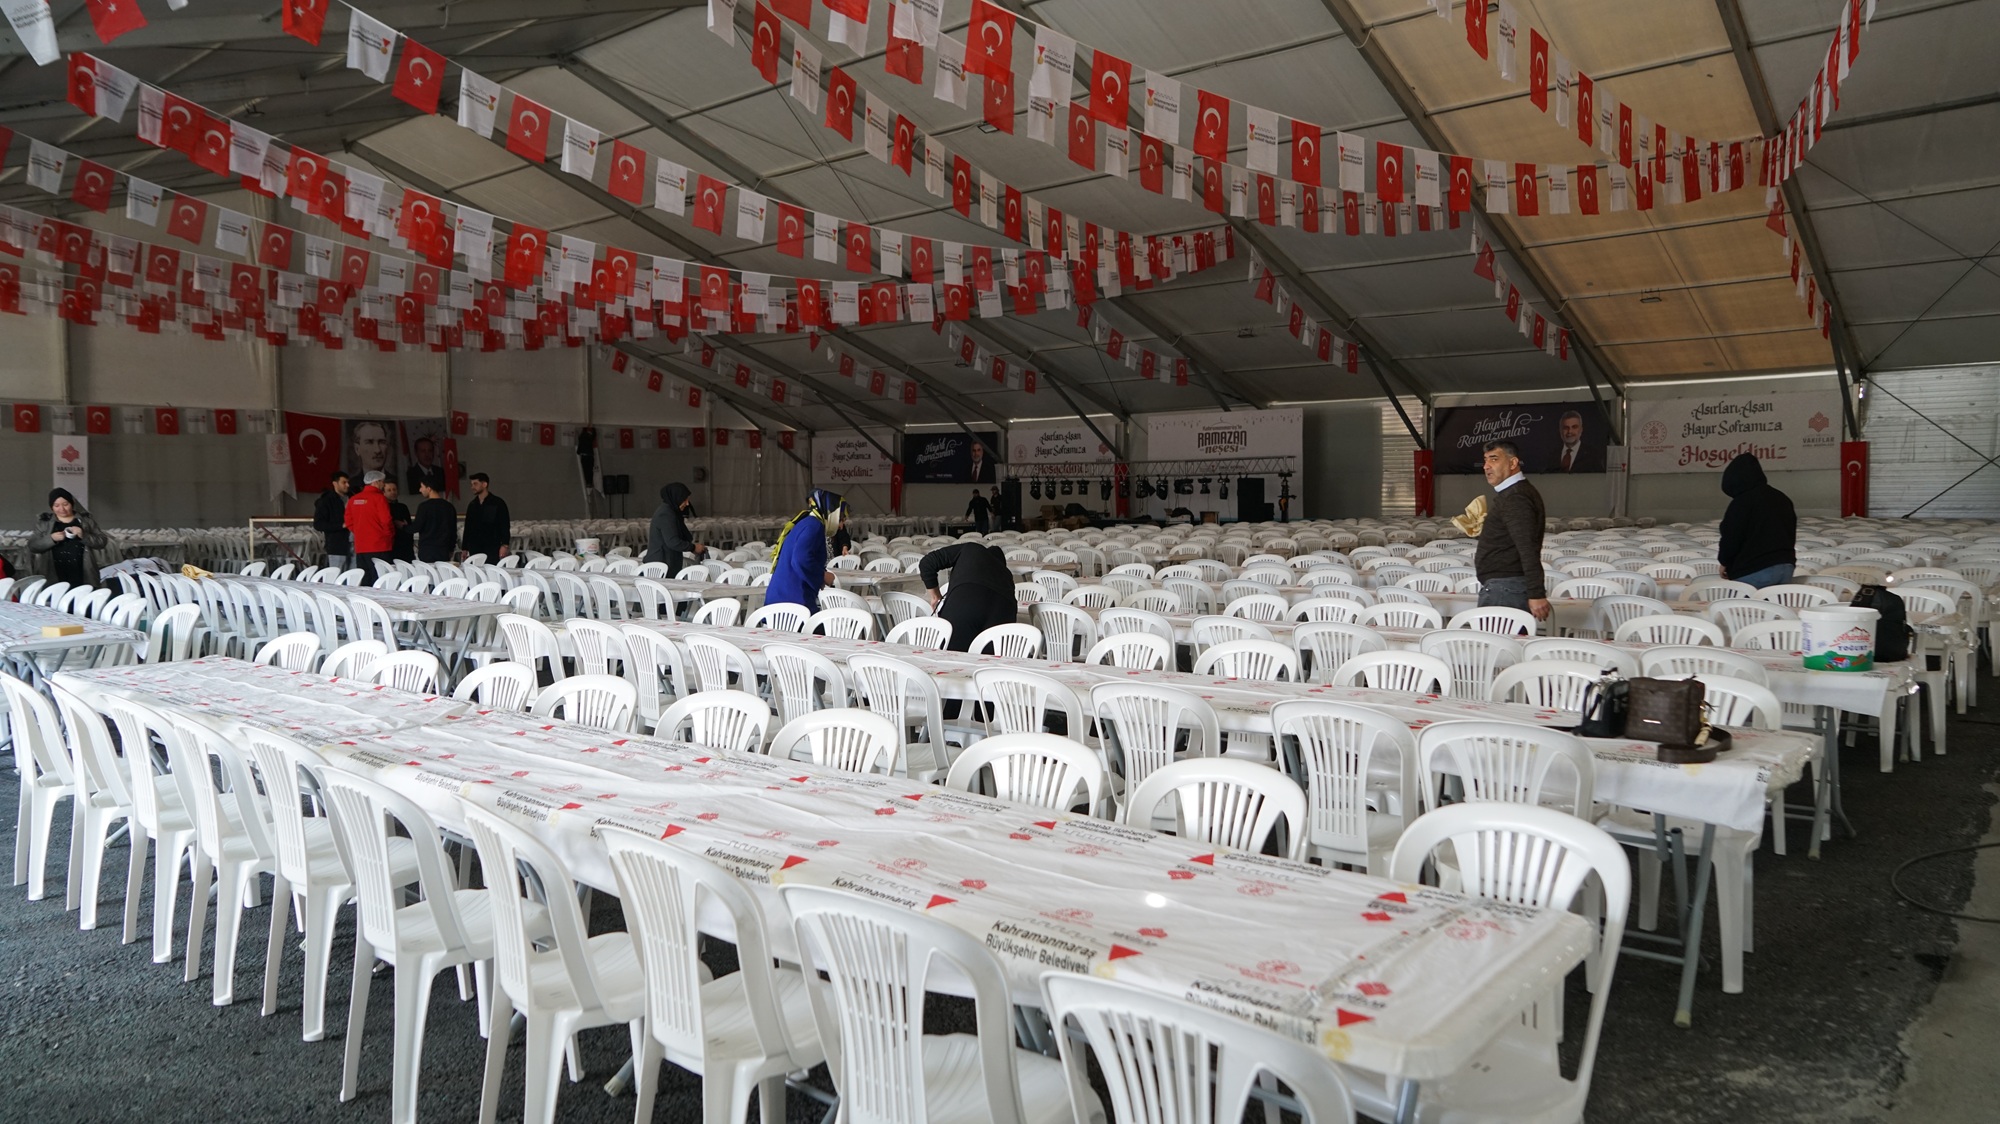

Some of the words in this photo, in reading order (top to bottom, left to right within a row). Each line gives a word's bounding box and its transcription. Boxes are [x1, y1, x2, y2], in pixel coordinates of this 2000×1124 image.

[1739, 400, 1773, 418] Aşan
[1473, 410, 1512, 435] Hayırlı
[1682, 422, 1716, 439] Hayır
[1718, 420, 1783, 436] Soframıza
[1197, 430, 1247, 448] RAMAZAN
[1205, 443, 1239, 455] neşesi
[704, 846, 775, 874] Kahramanmaraş
[831, 875, 918, 910] Kahramanmaraş
[991, 919, 1098, 959] Kahramanmaraş
[985, 932, 1036, 960] Büyükşehir
[1038, 948, 1090, 974] Belediyesi
